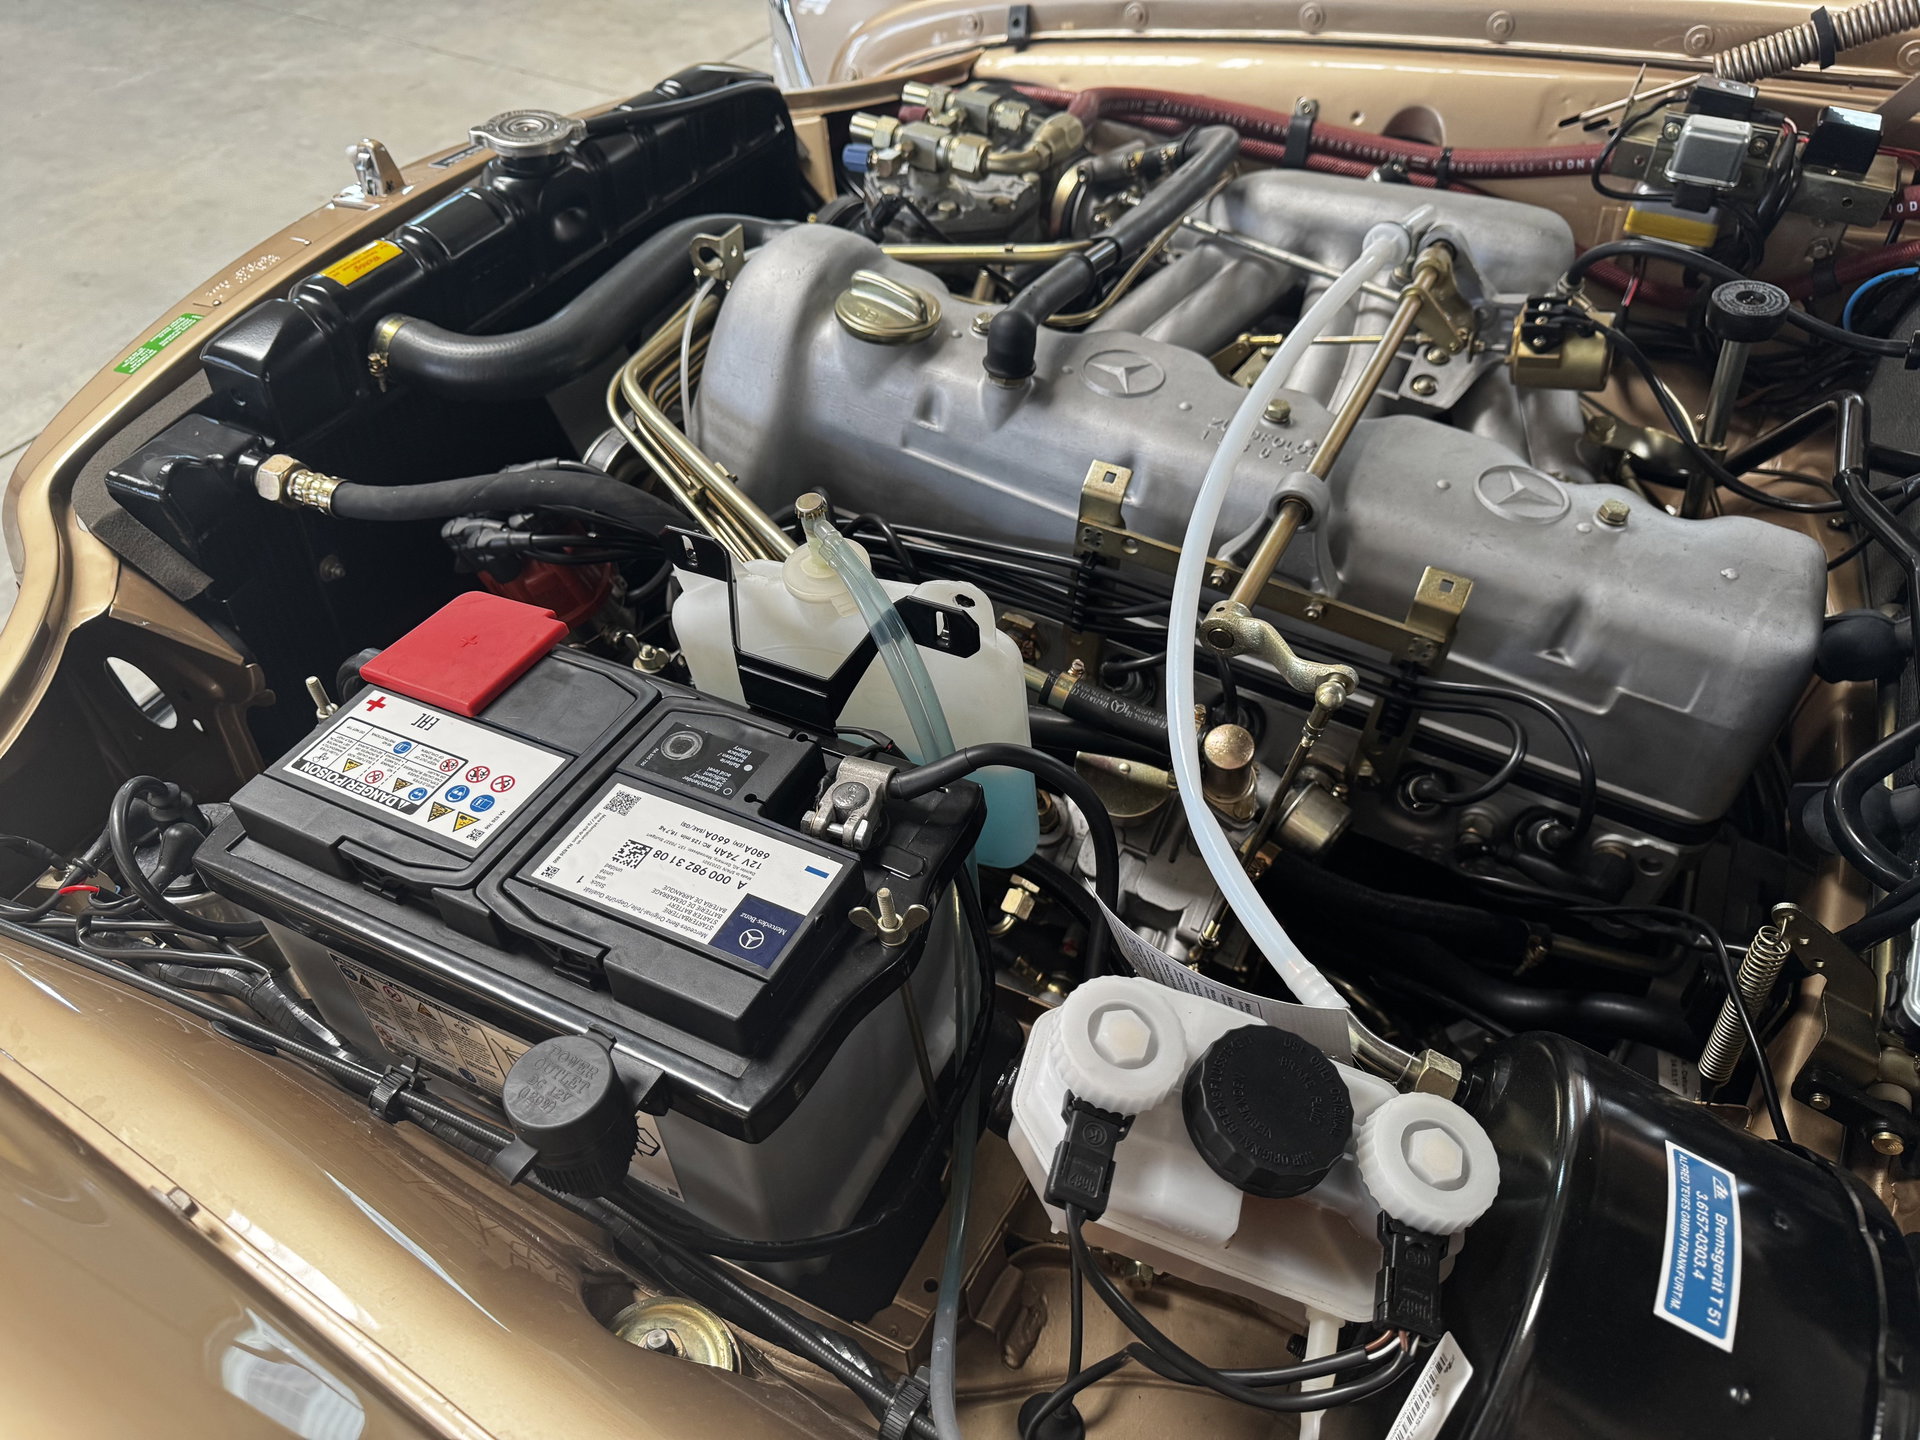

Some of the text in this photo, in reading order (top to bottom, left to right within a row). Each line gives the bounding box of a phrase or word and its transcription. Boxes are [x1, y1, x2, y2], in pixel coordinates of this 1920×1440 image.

[726, 749, 748, 759] Replace
[732, 745, 752, 754] battery
[718, 757, 740, 767] Batterie
[299, 761, 399, 806] DANGER/POISON
[681, 775, 719, 791] Ausreichender
[702, 770, 728, 782] Sufficient
[702, 830, 731, 845] 660A
[712, 846, 739, 861] 74Ah
[742, 845, 770, 859] 680A
[603, 862, 623, 873] unidad
[652, 849, 747, 890] A 000 982 31 08
[741, 857, 762, 869] 12V
[575, 875, 585, 884] 1
[589, 879, 606, 888] Stück
[582, 886, 605, 898] Qualität
[661, 884, 694, 900] ARRANQUE
[661, 906, 714, 931] STARTERBATTERIE
[666, 901, 718, 925] STARTER BATTERY
[694, 905, 723, 919] BATTERIE
[664, 917, 708, 939] Mercedes-Benz
[738, 911, 788, 935] Mercedes-Benz
[549, 1043, 600, 1080] POWER
[534, 1057, 591, 1095] OUTLET
[1678, 1153, 1689, 1184] ALFRED
[1679, 1182, 1690, 1211] TEVES
[1679, 1209, 1689, 1239] GMBH
[1692, 1189, 1709, 1282] 3.6157-0303.4
[1706, 1210, 1727, 1327] Bremsgerät T 51
